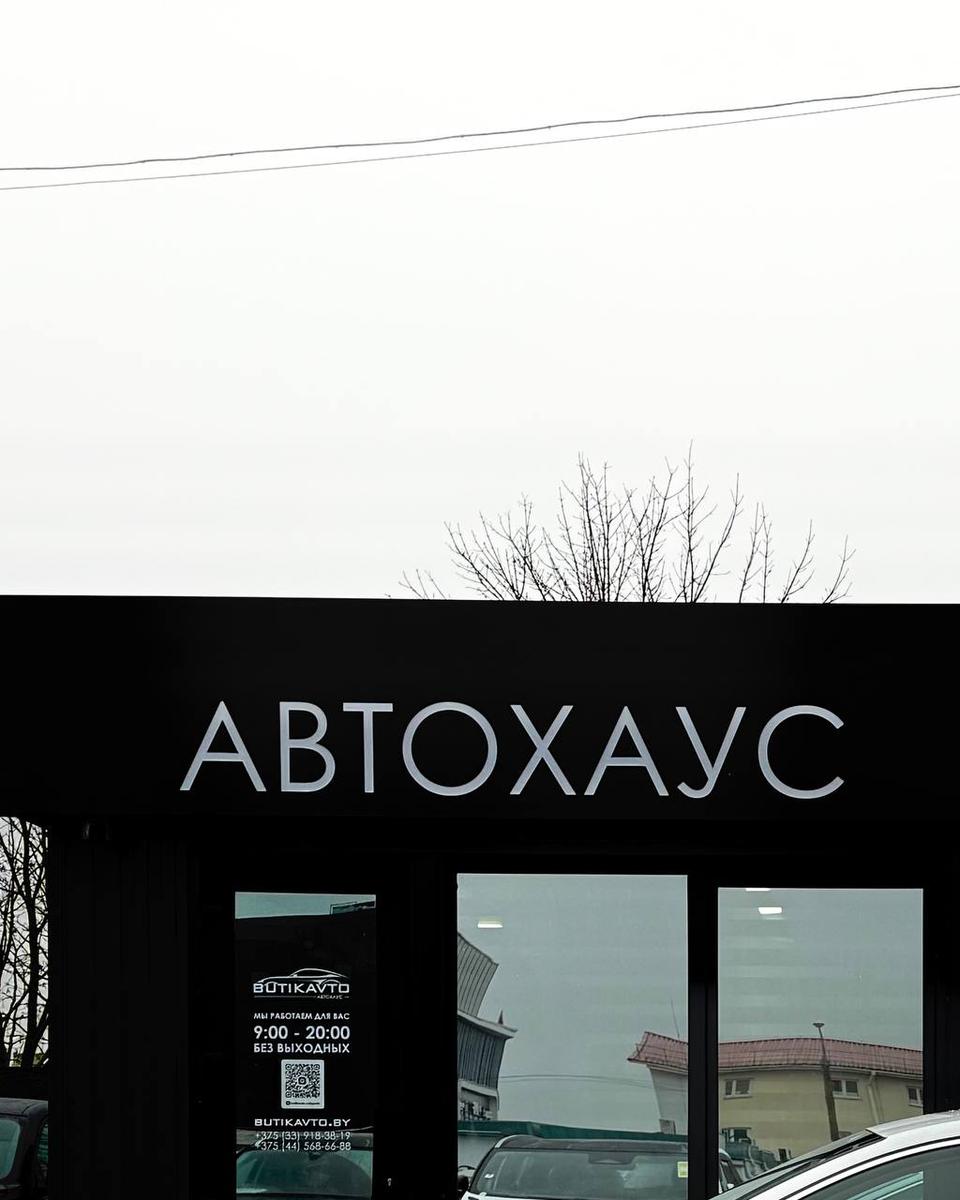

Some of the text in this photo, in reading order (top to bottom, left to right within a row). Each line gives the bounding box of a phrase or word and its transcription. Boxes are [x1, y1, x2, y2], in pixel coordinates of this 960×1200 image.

[180, 701, 845, 799] АВТОХАУС
[253, 983, 350, 993] BUTIKAVTO
[253, 1012, 350, 1020] МЫ РАБОТАЕМ ДЛЯ ВАС
[253, 1025, 288, 1040] 9:00
[305, 1025, 351, 1040] 20:00
[253, 1043, 350, 1054] БЕЗ ВЫХОДНЫХ
[254, 1118, 351, 1127] BUTIKAVTO.BY
[255, 1131, 351, 1141] +375 (33) 918-38-19
[281, 1141, 300, 1152] (44)
[303, 1141, 352, 1151] 568-66-88
